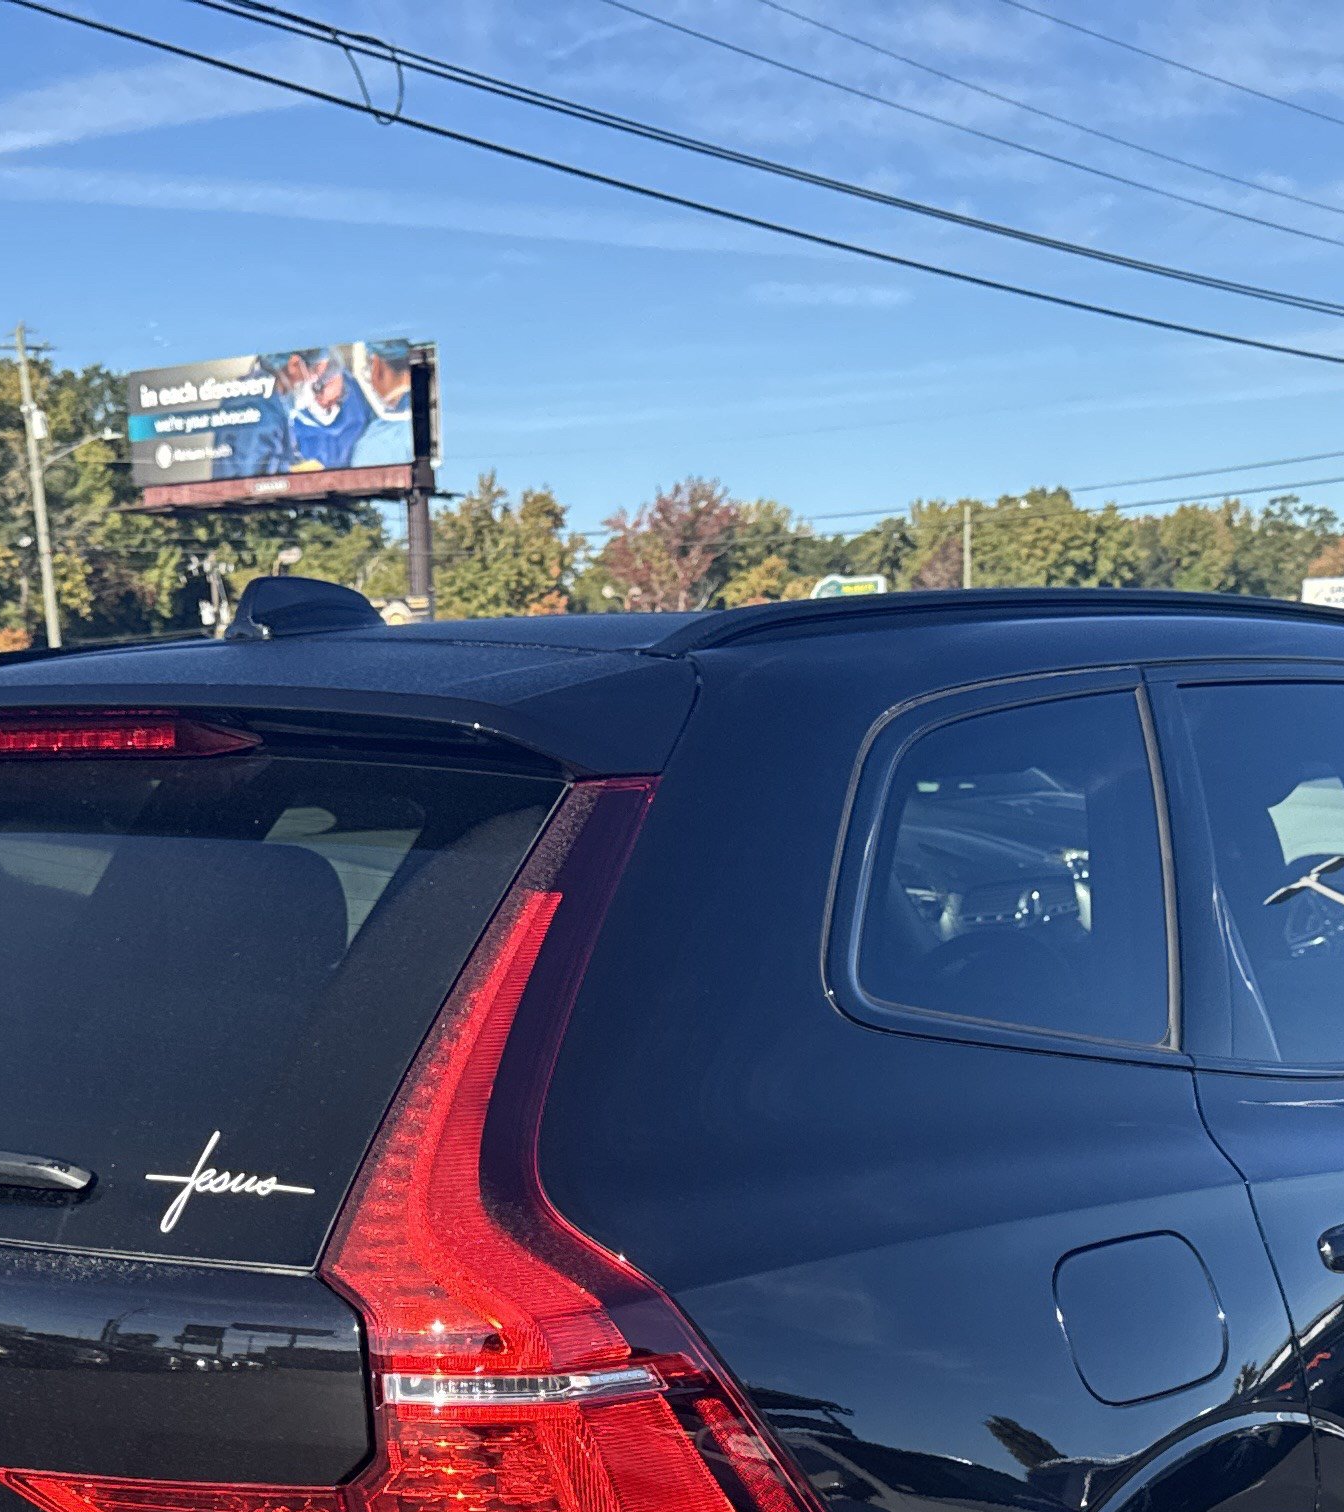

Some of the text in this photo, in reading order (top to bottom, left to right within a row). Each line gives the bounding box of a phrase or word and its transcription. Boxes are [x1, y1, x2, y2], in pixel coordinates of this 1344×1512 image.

[140, 377, 276, 408] in each discovery
[185, 414, 210, 433] your
[144, 1130, 316, 1234] Jesus
